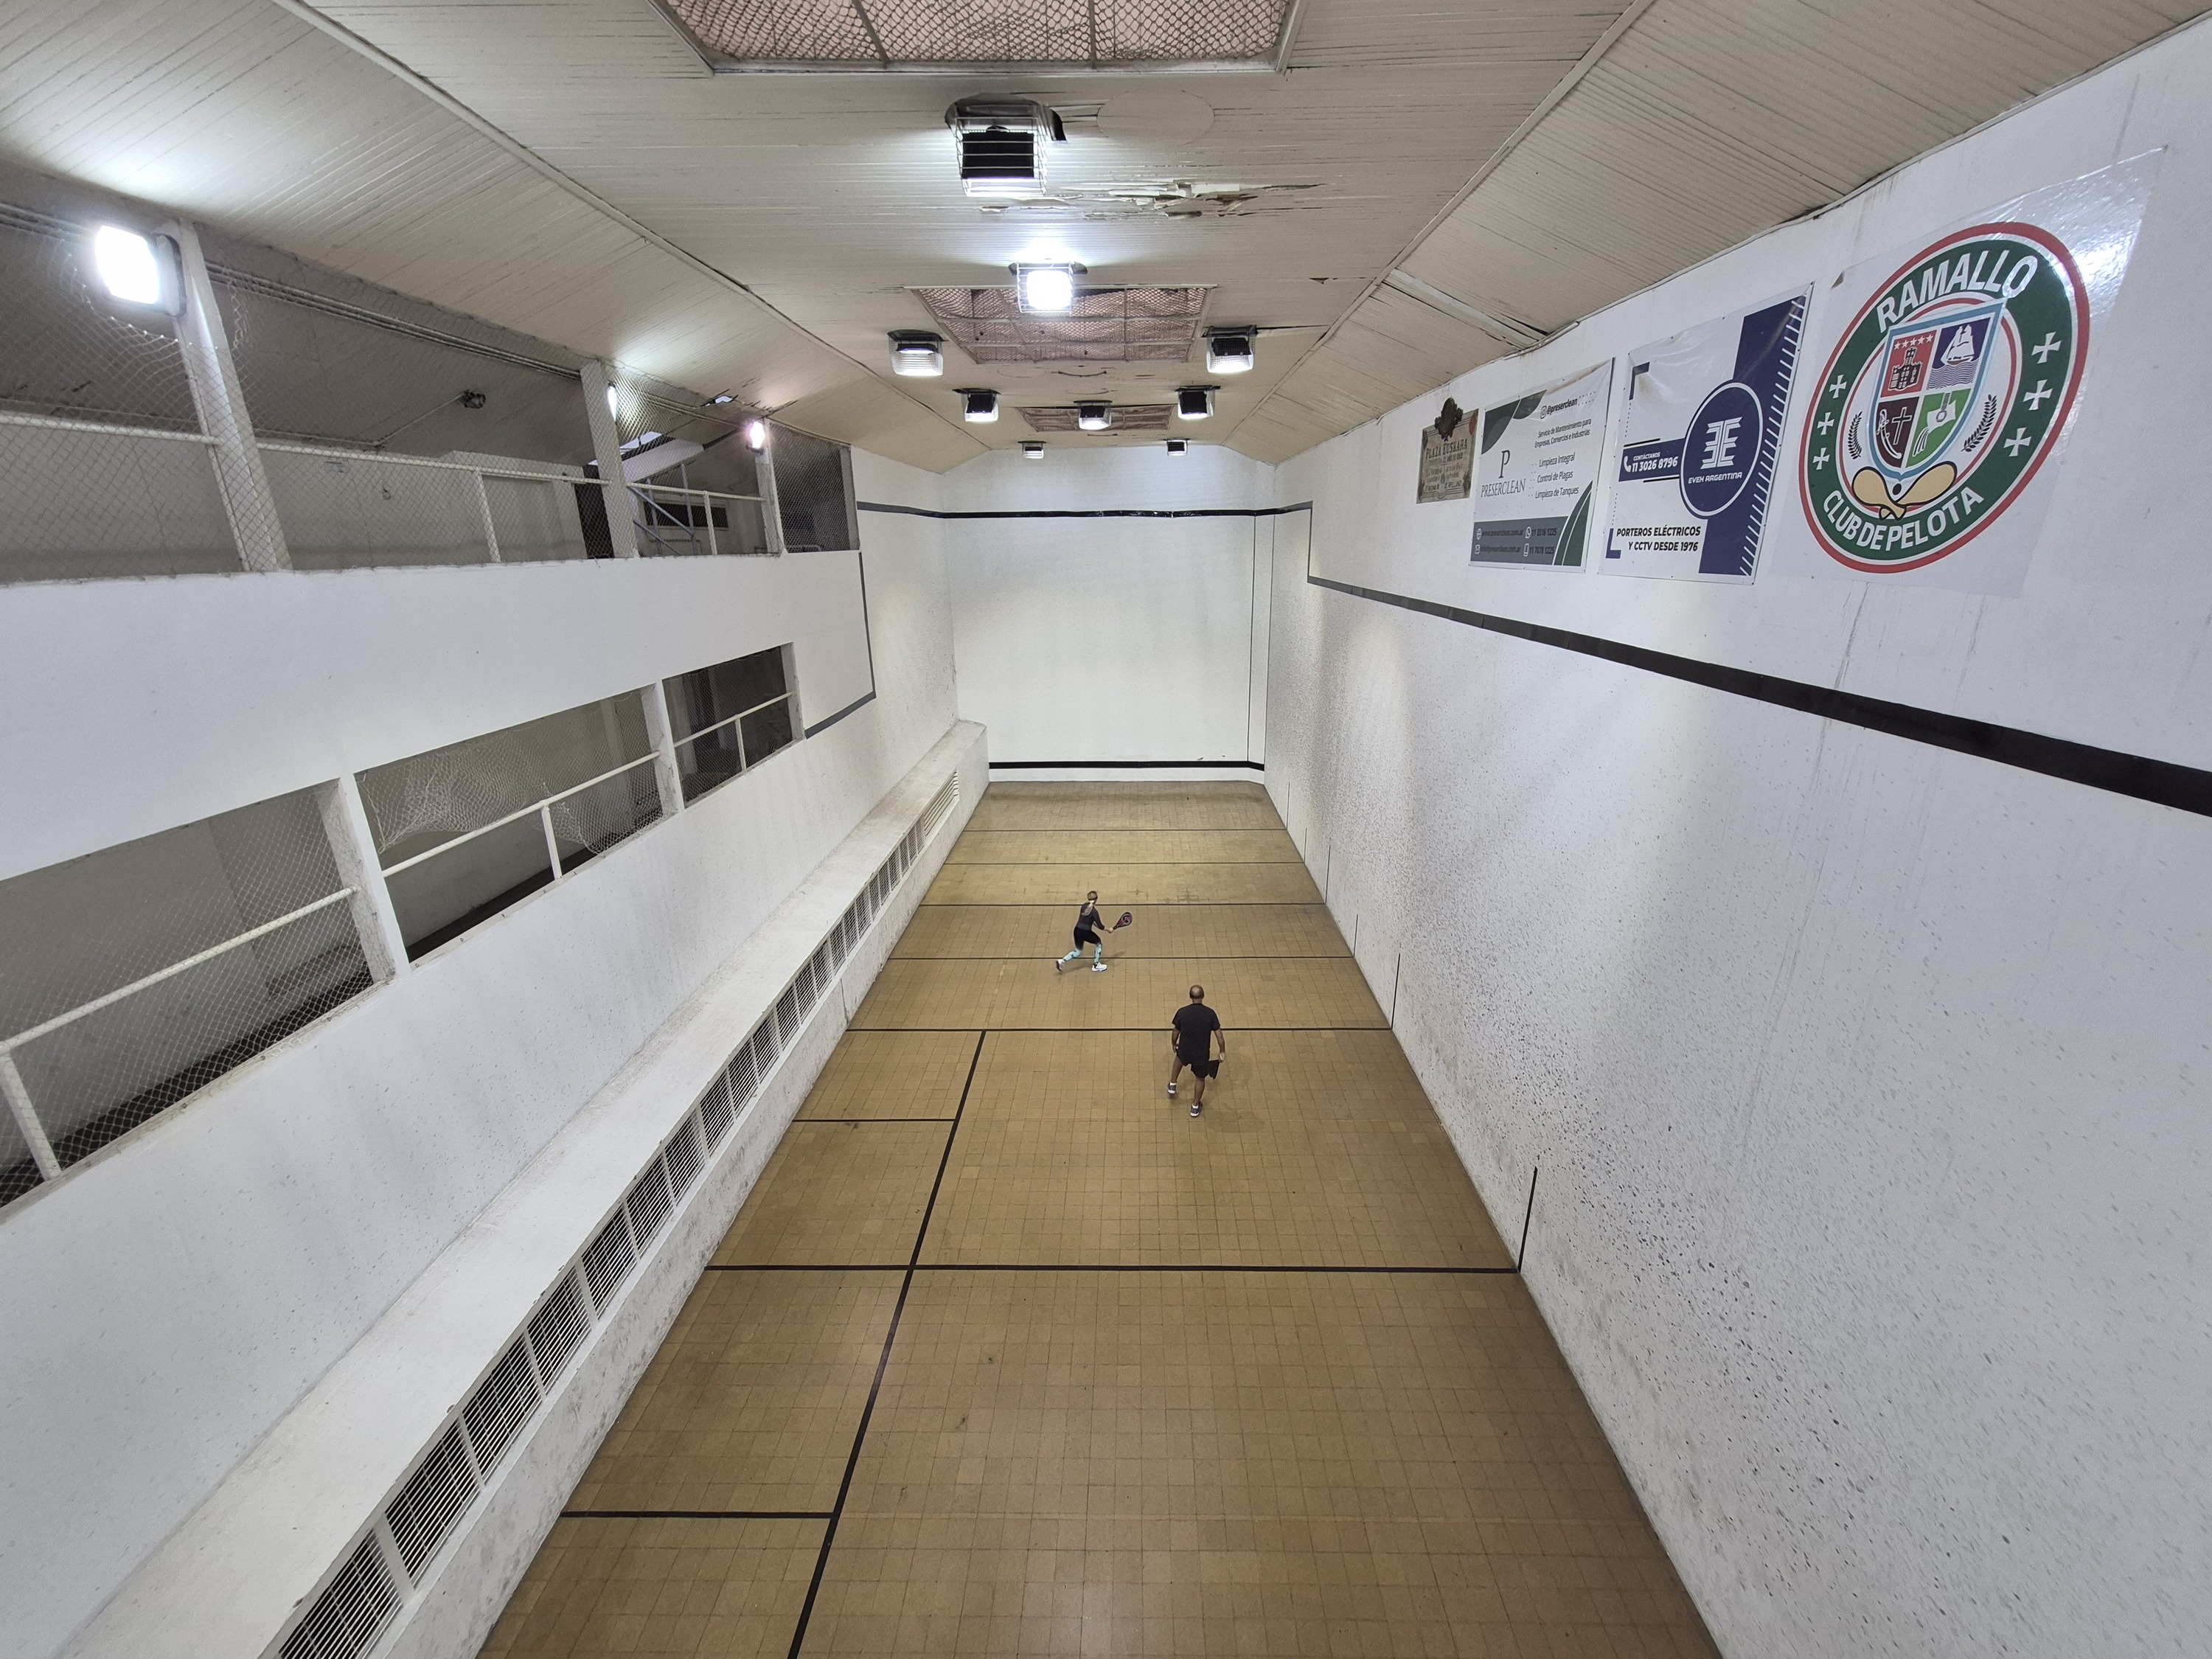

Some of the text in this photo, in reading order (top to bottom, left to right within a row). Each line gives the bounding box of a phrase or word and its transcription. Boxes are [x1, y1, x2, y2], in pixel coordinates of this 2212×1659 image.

[1876, 250, 2038, 333] RAMALLO
[1547, 398, 1578, 415] @preserclean
[1538, 429, 1550, 438] Servicio
[1555, 421, 1582, 434] Mantenimiento
[1582, 418, 1591, 428] para
[1551, 434, 1568, 444] Comercios
[1571, 429, 1590, 439] Industrias
[1425, 438, 1467, 459] PLAZA EUSKARA
[1633, 452, 1660, 461] CONTÁCTANOS
[1498, 450, 1510, 479] P
[1539, 451, 1576, 468] Limpieza Integral
[1632, 456, 1679, 473] 11 3026 8796
[1537, 470, 1573, 483] Control de Plagas
[1705, 471, 1743, 482] ARGENTINA
[1481, 478, 1526, 498] PRESERCLEAN
[1535, 487, 1579, 500] Limpieza de Tanques
[1823, 486, 1984, 551] CLUB DE PELOTA
[1616, 524, 1701, 537] PORTEROS ELÉCTRICOS
[1628, 541, 1699, 552] Y CCTV DESDE 1976
